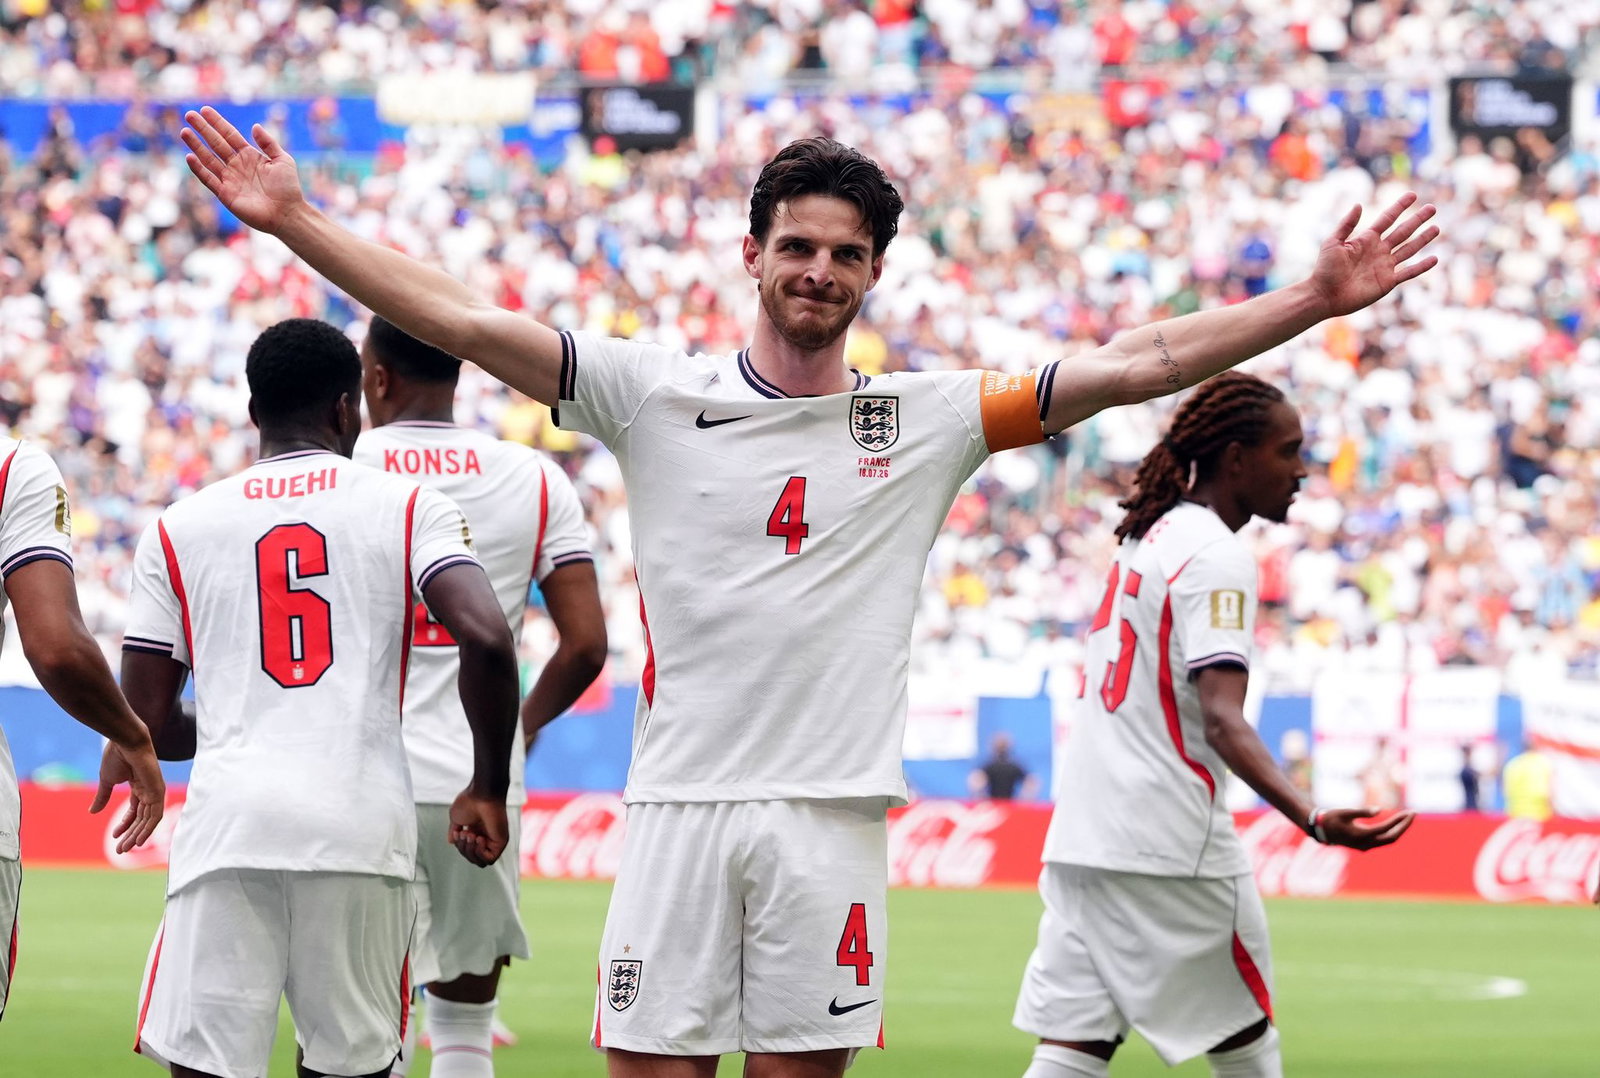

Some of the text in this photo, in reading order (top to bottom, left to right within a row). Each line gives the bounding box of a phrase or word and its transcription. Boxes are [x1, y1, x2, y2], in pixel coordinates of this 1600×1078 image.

[242, 467, 338, 500] GUEHI
[383, 448, 482, 476] KONSA
[857, 456, 892, 468] FRANCE
[766, 475, 810, 556] 4
[254, 521, 335, 689] 6
[836, 902, 874, 987] 4
